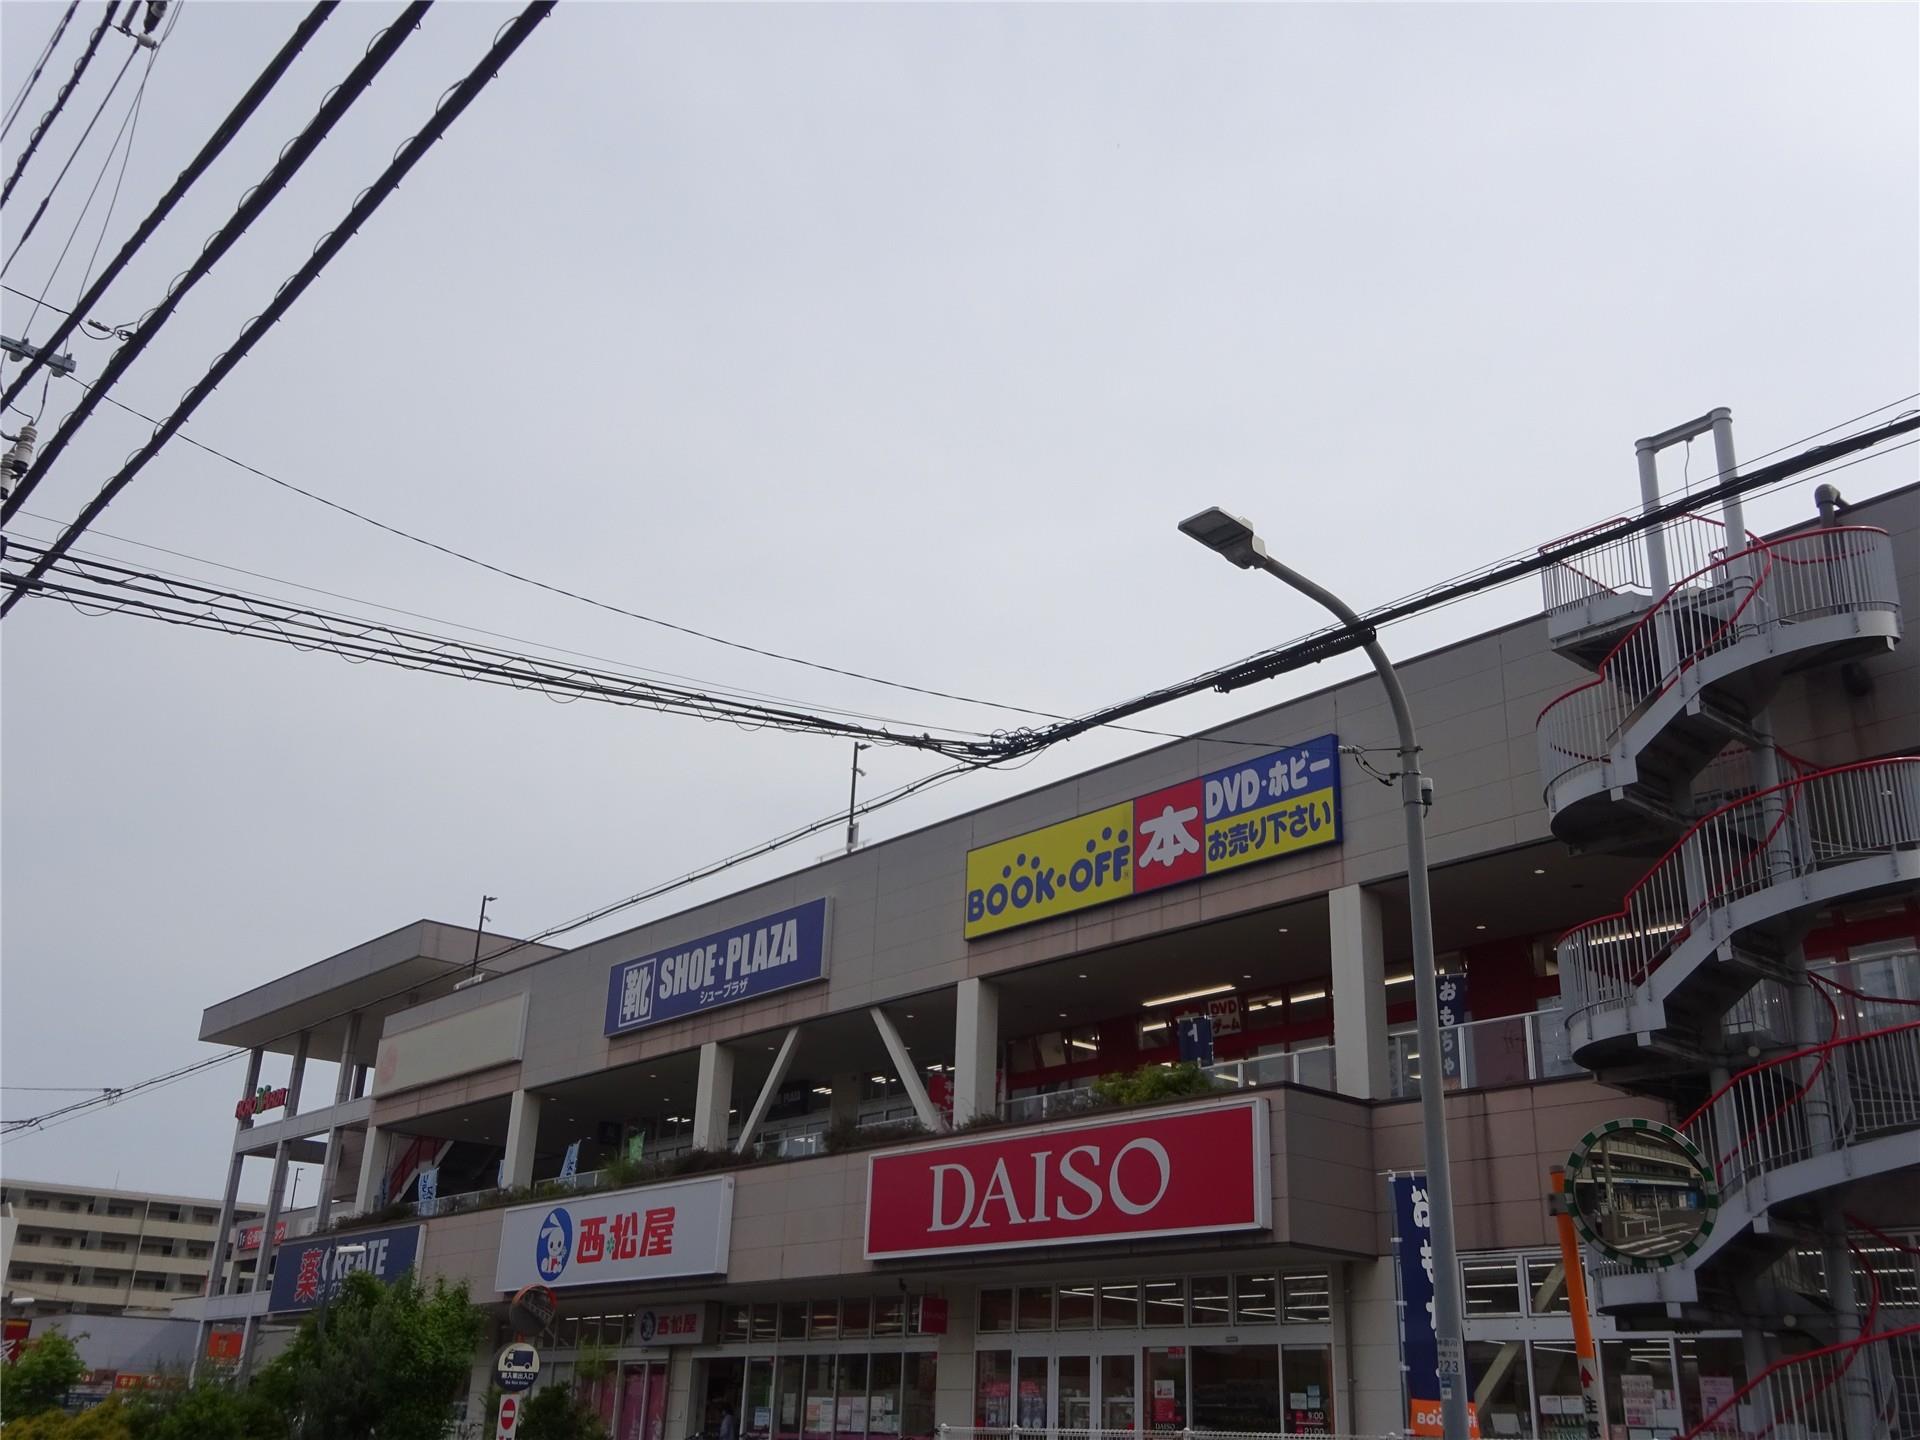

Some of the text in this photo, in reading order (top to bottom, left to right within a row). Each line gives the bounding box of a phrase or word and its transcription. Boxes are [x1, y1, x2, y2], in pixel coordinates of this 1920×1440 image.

[1138, 804, 1200, 868] 本
[1207, 800, 1332, 861] お売り下さい
[623, 966, 651, 1021] 靴
[700, 978, 749, 1004] シュープラザ
[1210, 1000, 1237, 1014] DVD
[927, 1137, 1171, 1233] DAISO
[576, 1206, 676, 1265] 西松屋
[294, 1248, 323, 1303] 薬
[657, 1313, 697, 1335] 西松屋
